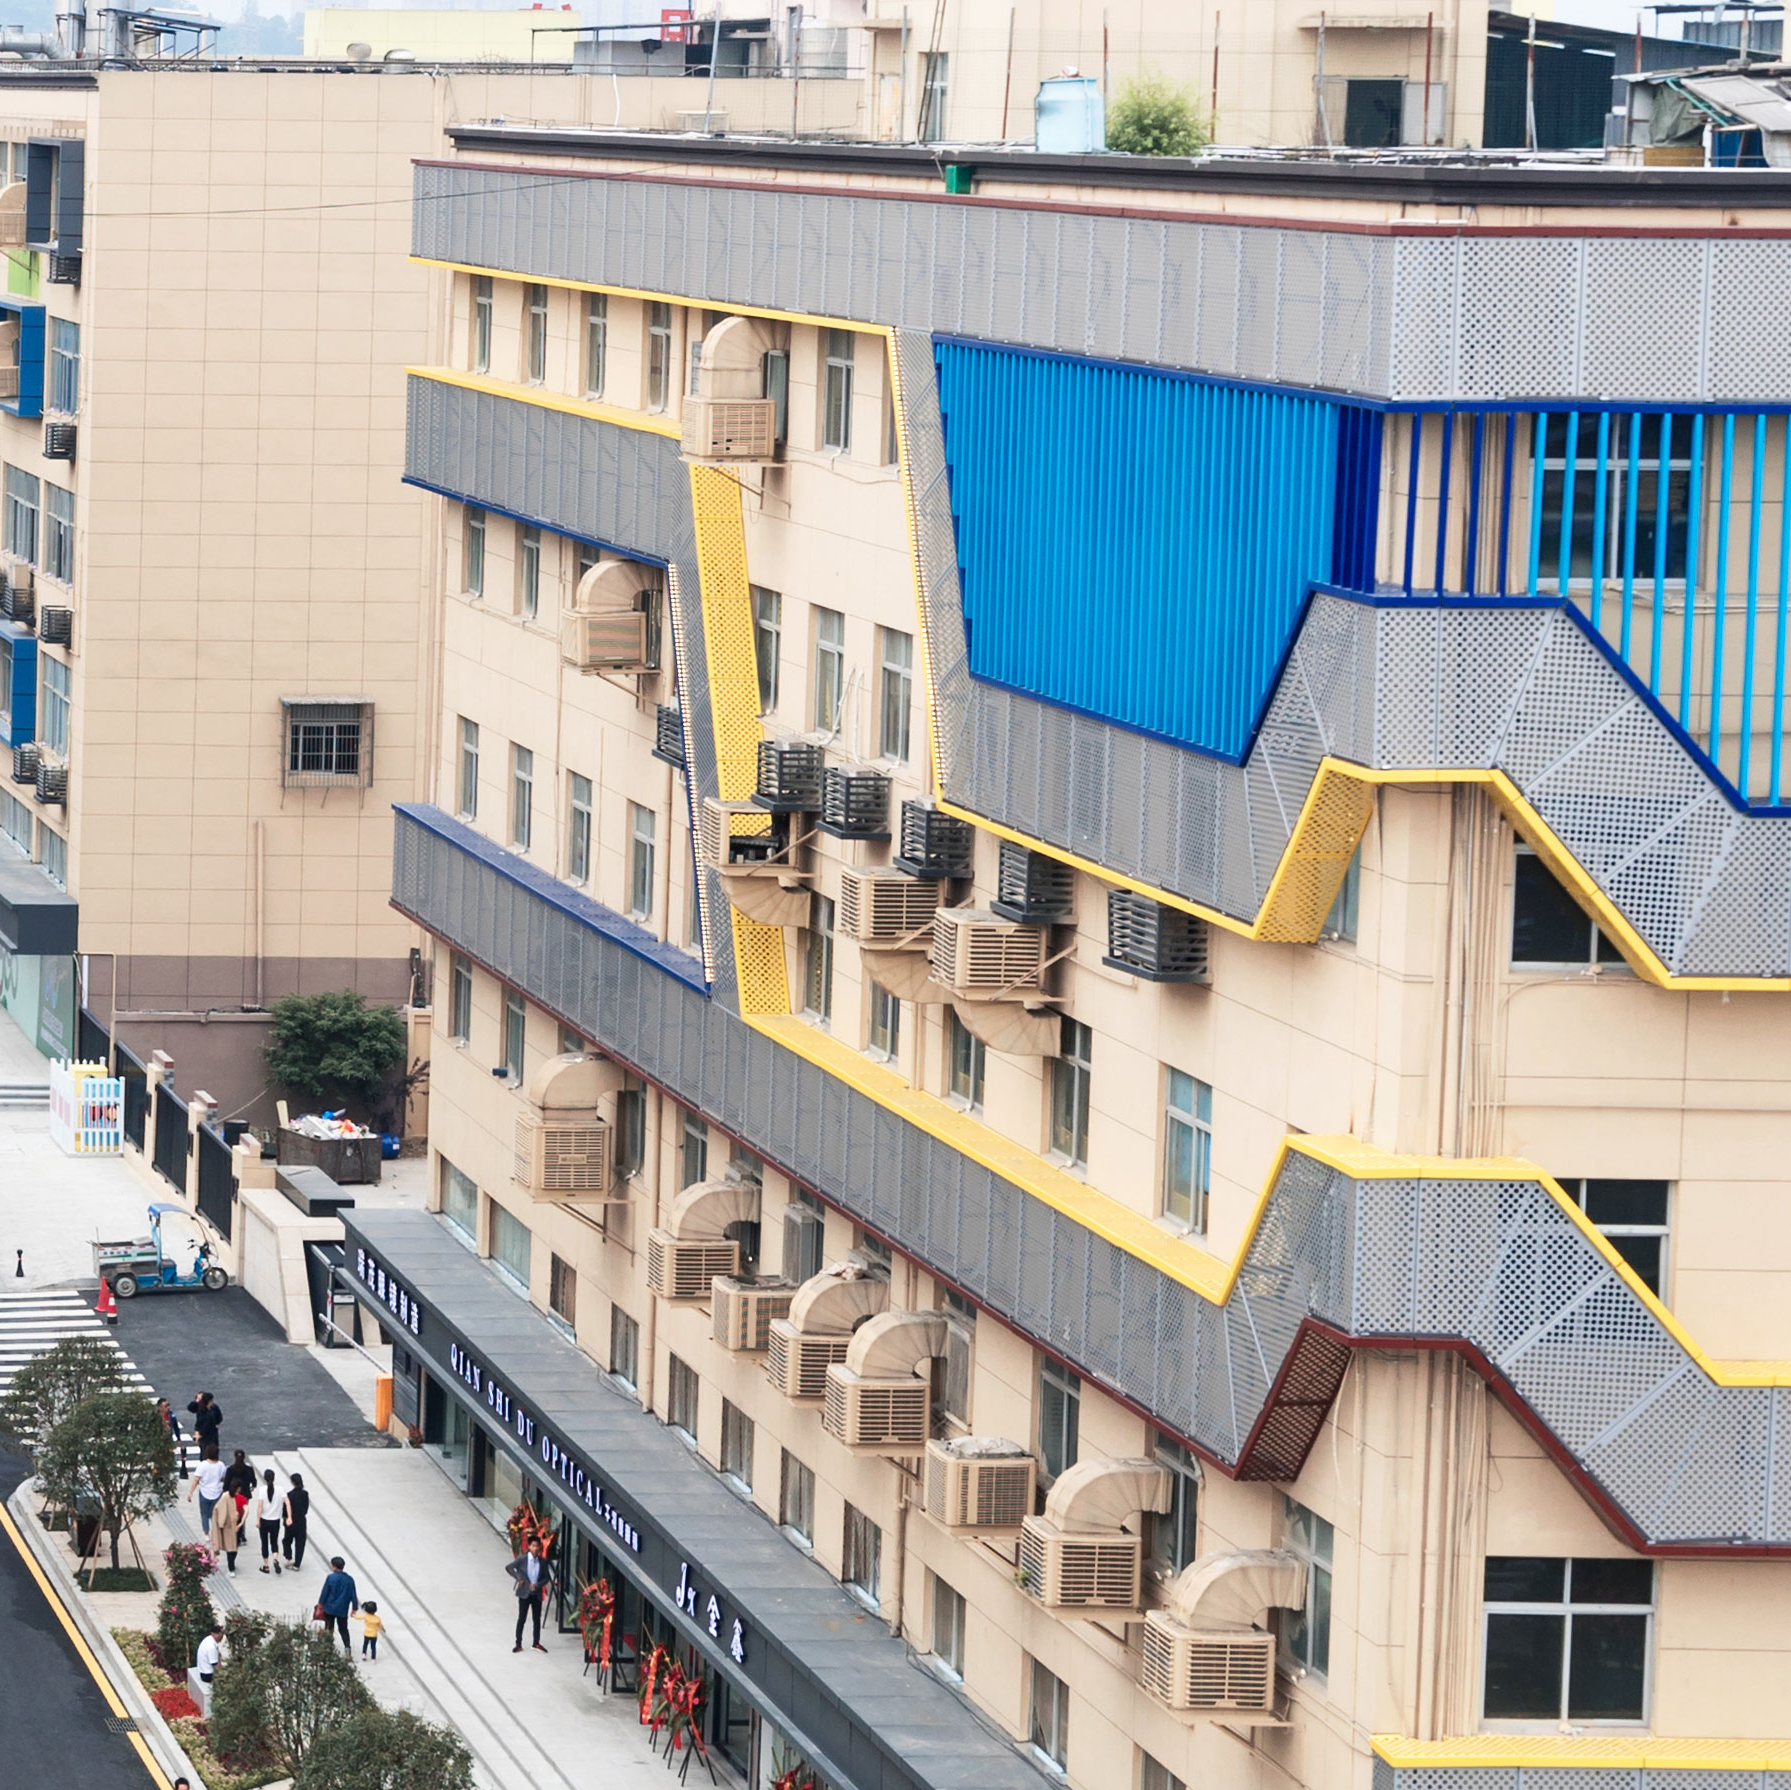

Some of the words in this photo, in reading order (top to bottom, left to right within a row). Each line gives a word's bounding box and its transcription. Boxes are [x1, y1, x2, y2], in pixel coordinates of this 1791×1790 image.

[450, 1343, 480, 1392] QIAN
[488, 1381, 510, 1422] SHI
[517, 1409, 534, 1445] DU
[542, 1435, 603, 1515] OPTICAL
